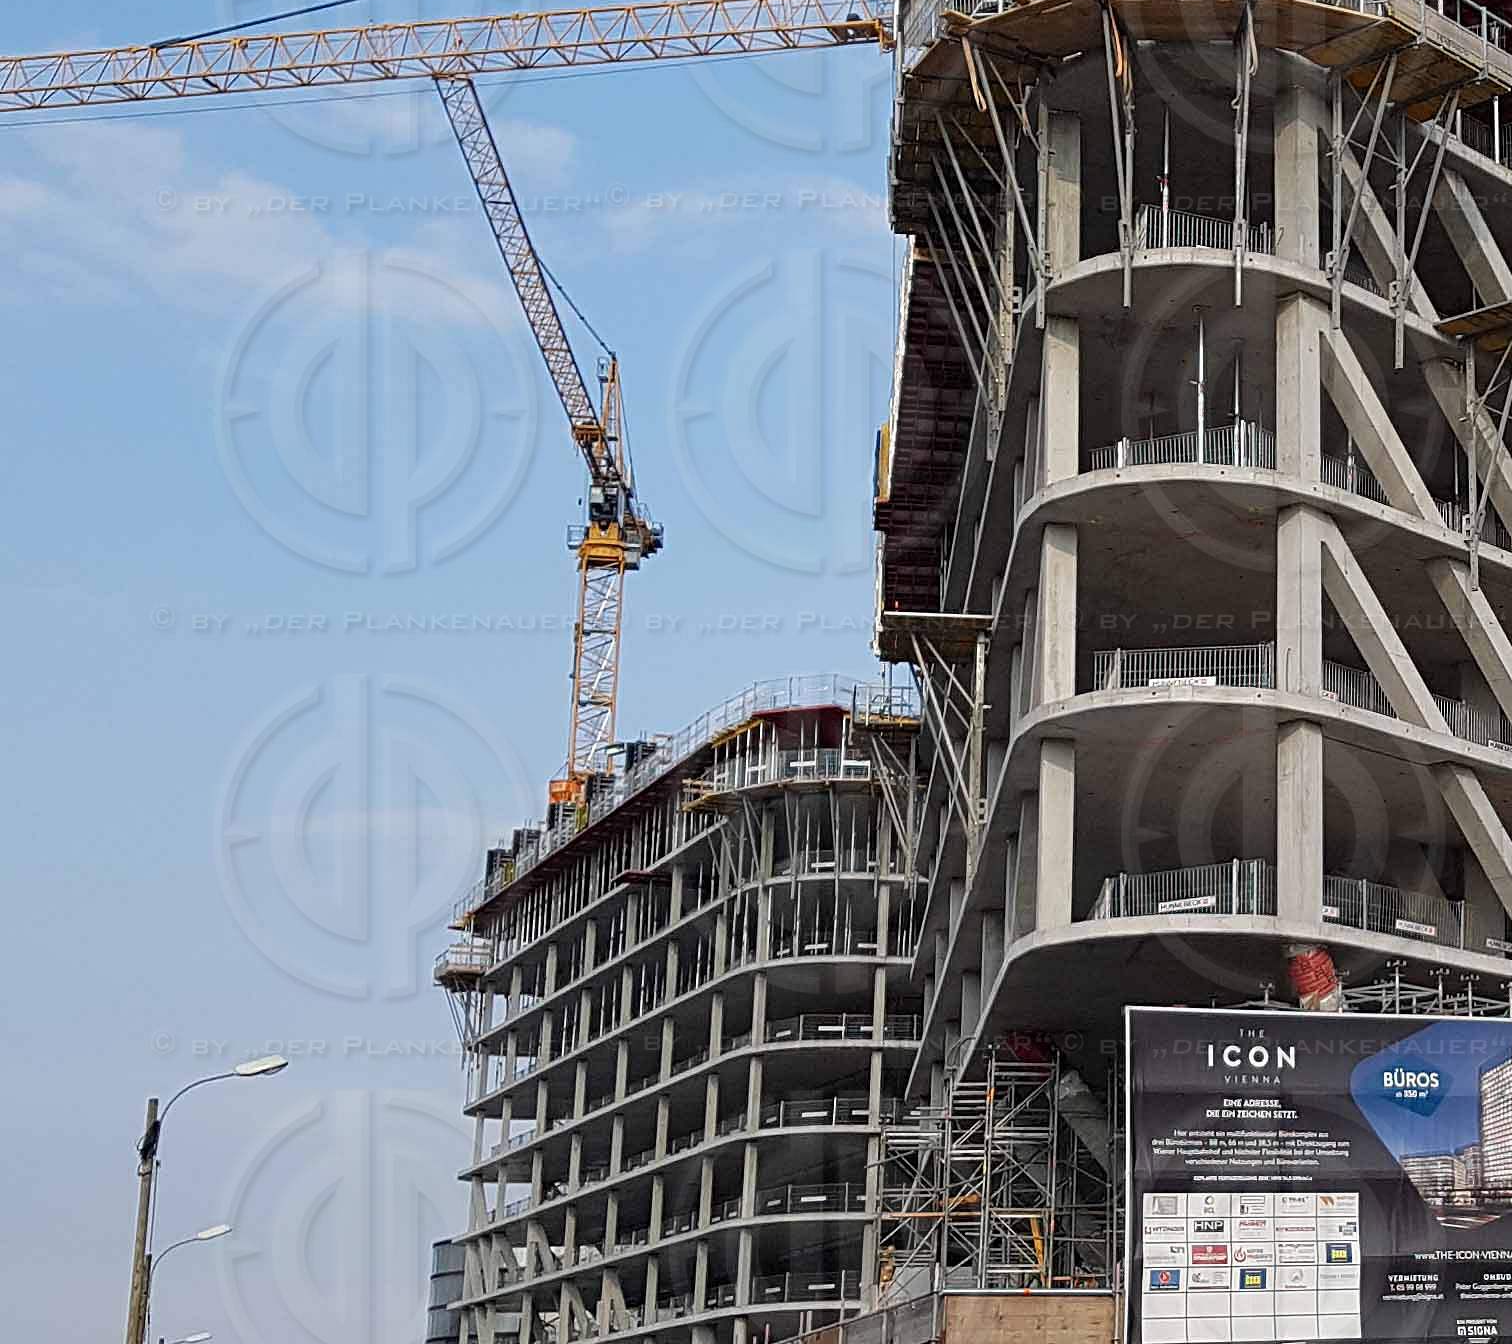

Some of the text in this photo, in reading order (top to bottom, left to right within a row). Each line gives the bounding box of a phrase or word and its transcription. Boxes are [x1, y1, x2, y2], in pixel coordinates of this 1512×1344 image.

[1239, 1028, 1265, 1038] THE
[1207, 1044, 1296, 1068] ICON
[1224, 1075, 1281, 1085] VIENNA
[1383, 1068, 1440, 1088] BÜROS
[1223, 1099, 1282, 1109] EINE ADRESSE,
[1273, 1111, 1298, 1119] SETZT.
[1194, 1221, 1223, 1231] HNP
[1468, 1326, 1498, 1336] SIGNA
